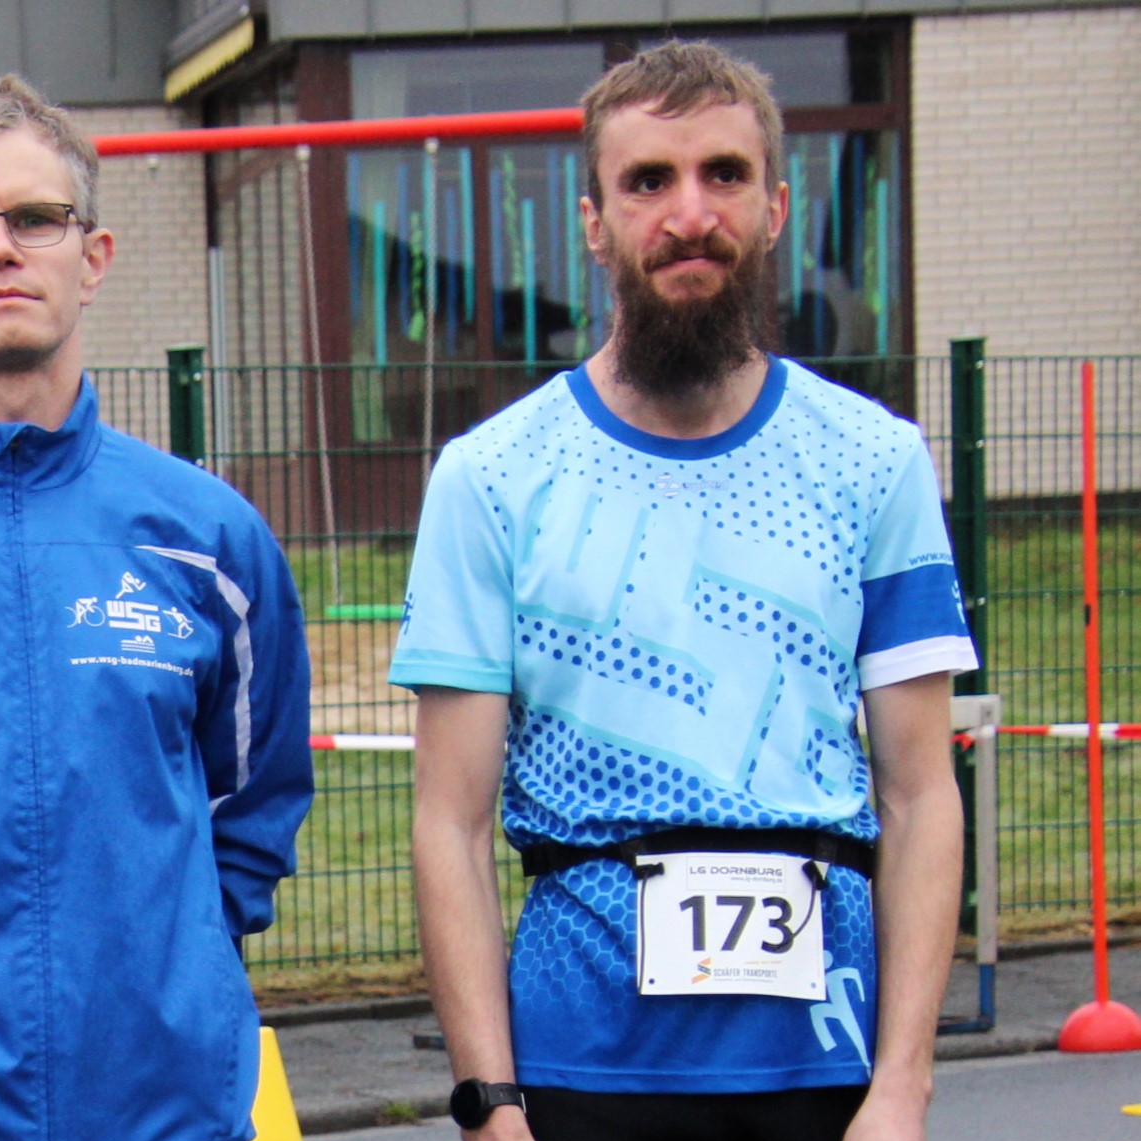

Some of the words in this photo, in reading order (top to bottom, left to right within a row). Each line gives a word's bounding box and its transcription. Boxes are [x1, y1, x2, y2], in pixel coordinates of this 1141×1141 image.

[106, 600, 161, 632] WSG
[689, 866, 707, 875] LG
[710, 866, 783, 877] DORNBURG
[679, 895, 794, 954] 173
